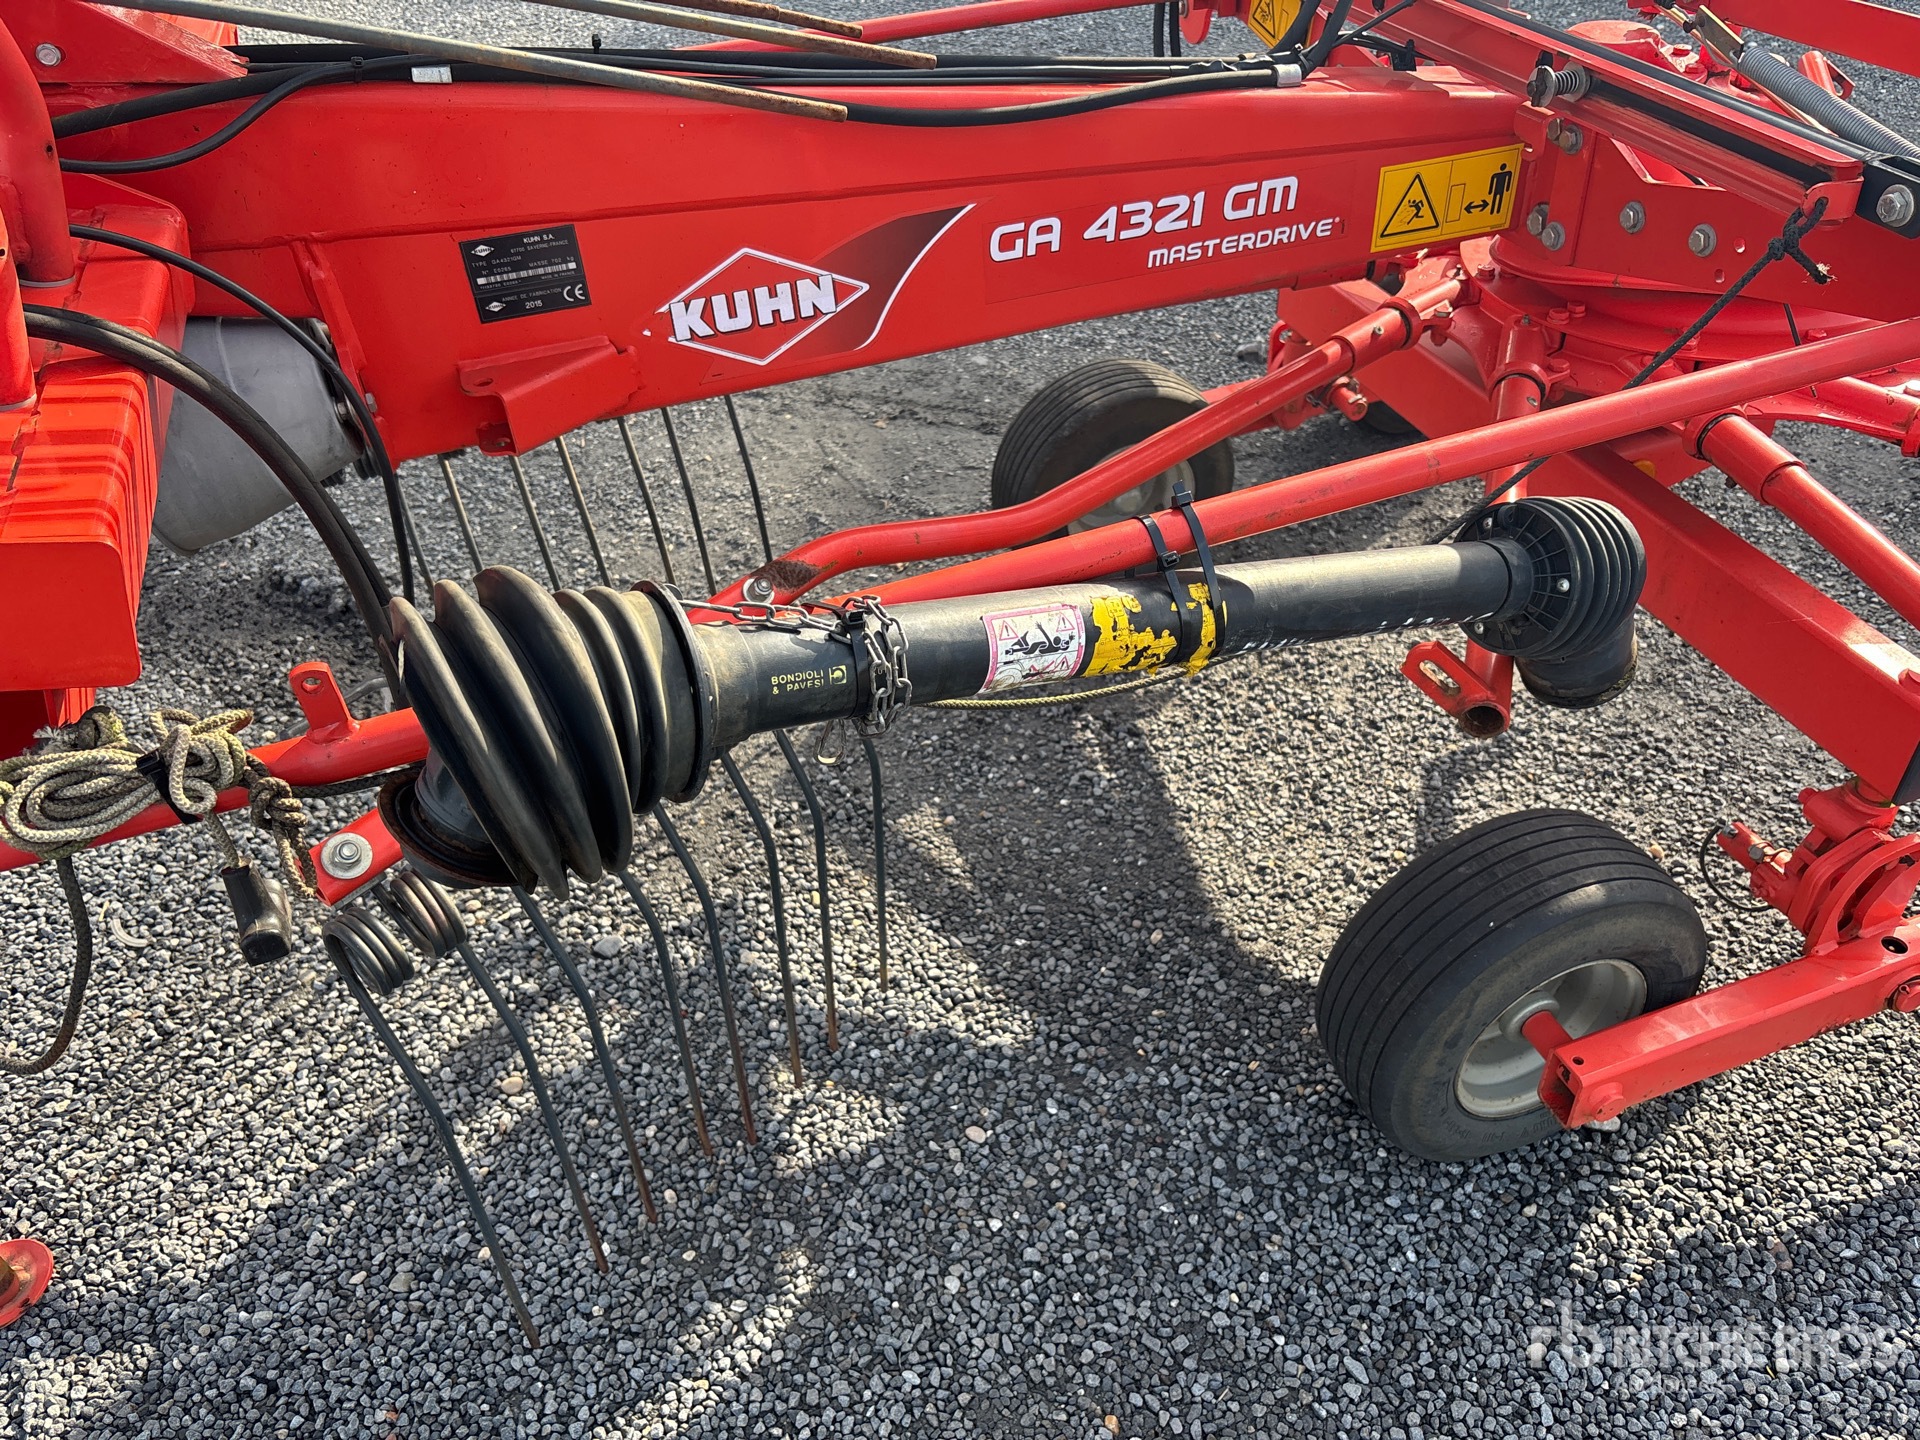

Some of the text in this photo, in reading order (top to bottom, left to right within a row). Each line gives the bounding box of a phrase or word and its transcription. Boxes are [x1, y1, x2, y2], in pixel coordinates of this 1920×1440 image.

[989, 176, 1299, 263] GA 4321 GM
[523, 234, 541, 243] KUHN
[525, 300, 543, 309] 2015
[669, 274, 837, 341] KUHN
[771, 669, 824, 685] BONDIOLI
[772, 678, 824, 694] & PAVESI
